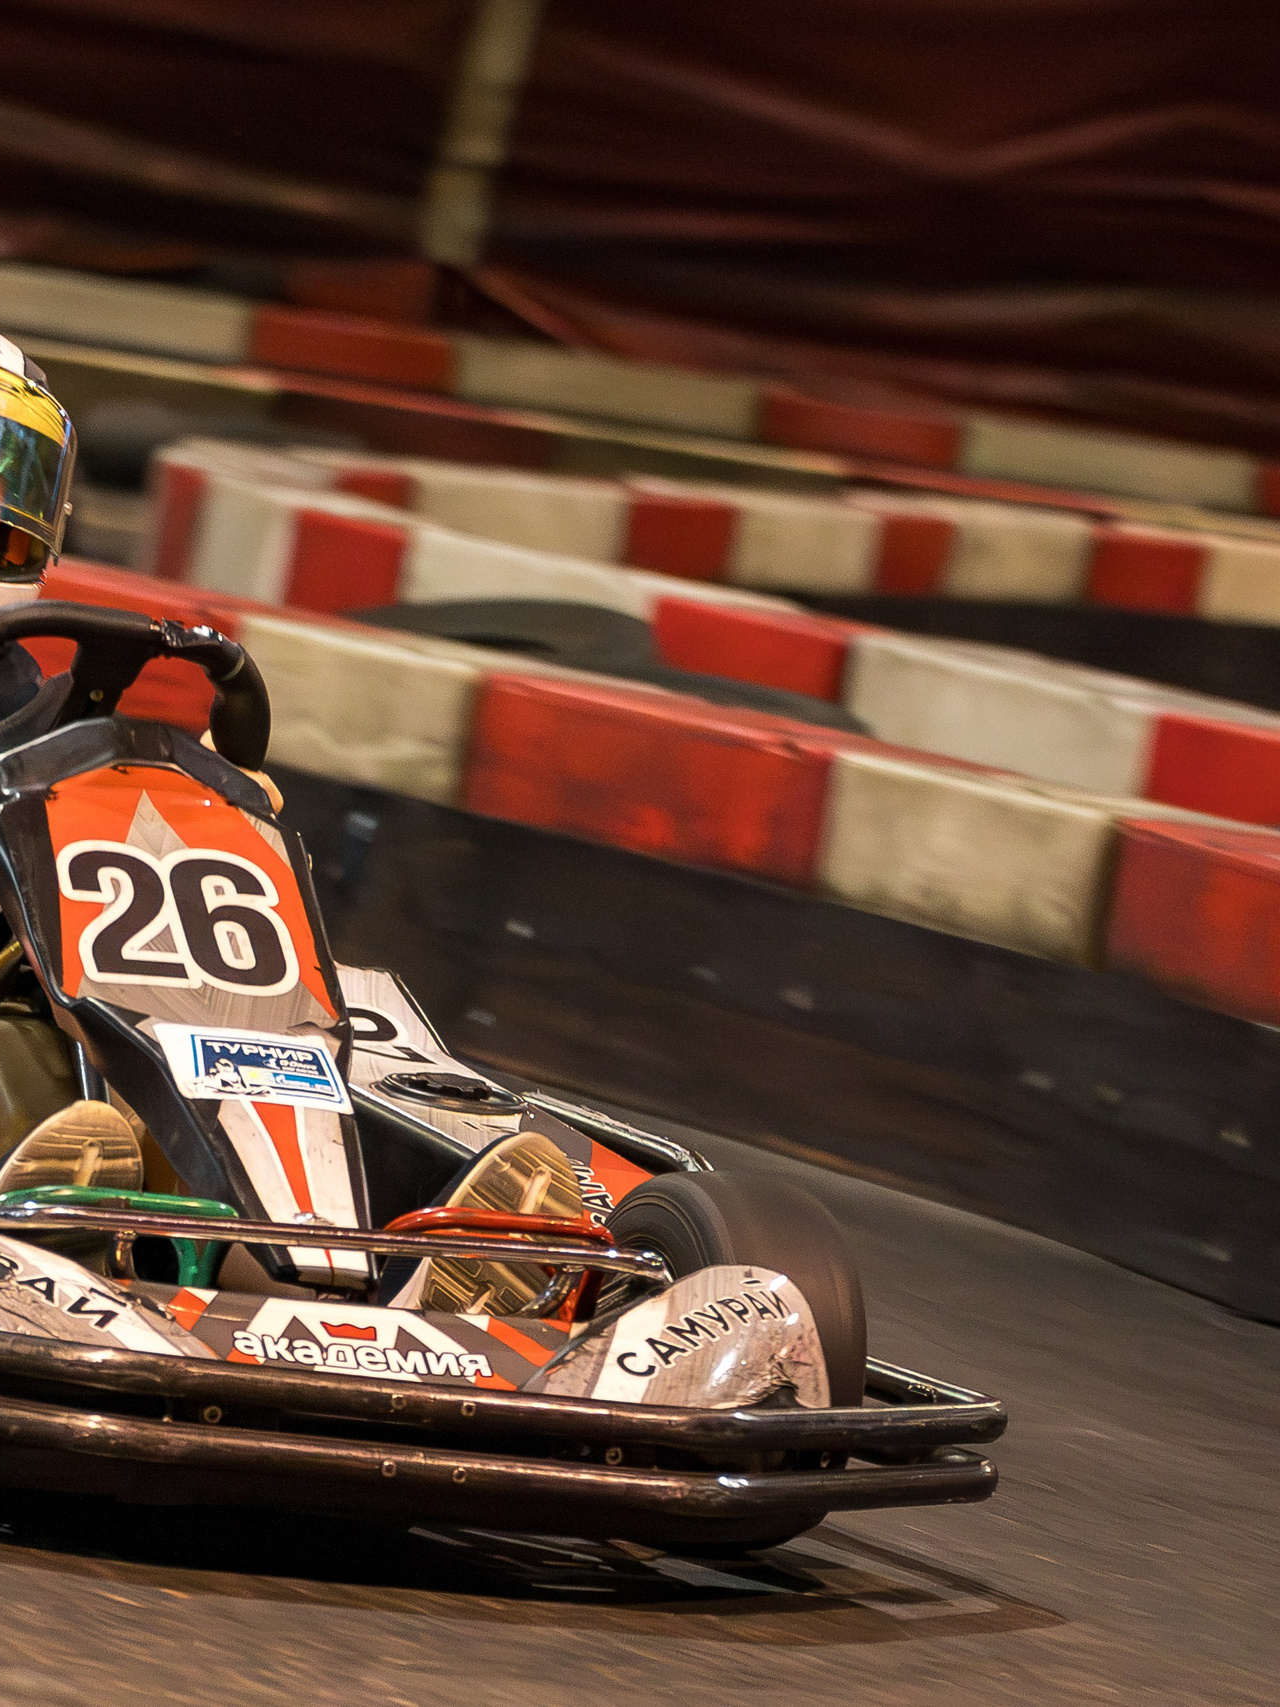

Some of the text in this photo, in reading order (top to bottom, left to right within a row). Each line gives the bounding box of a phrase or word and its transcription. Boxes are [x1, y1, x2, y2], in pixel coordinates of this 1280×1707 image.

[62, 845, 294, 991] 26
[205, 1041, 314, 1062] ТУРНИР
[232, 1330, 494, 1378] академия
[616, 1279, 790, 1377] САМУРАЙ
